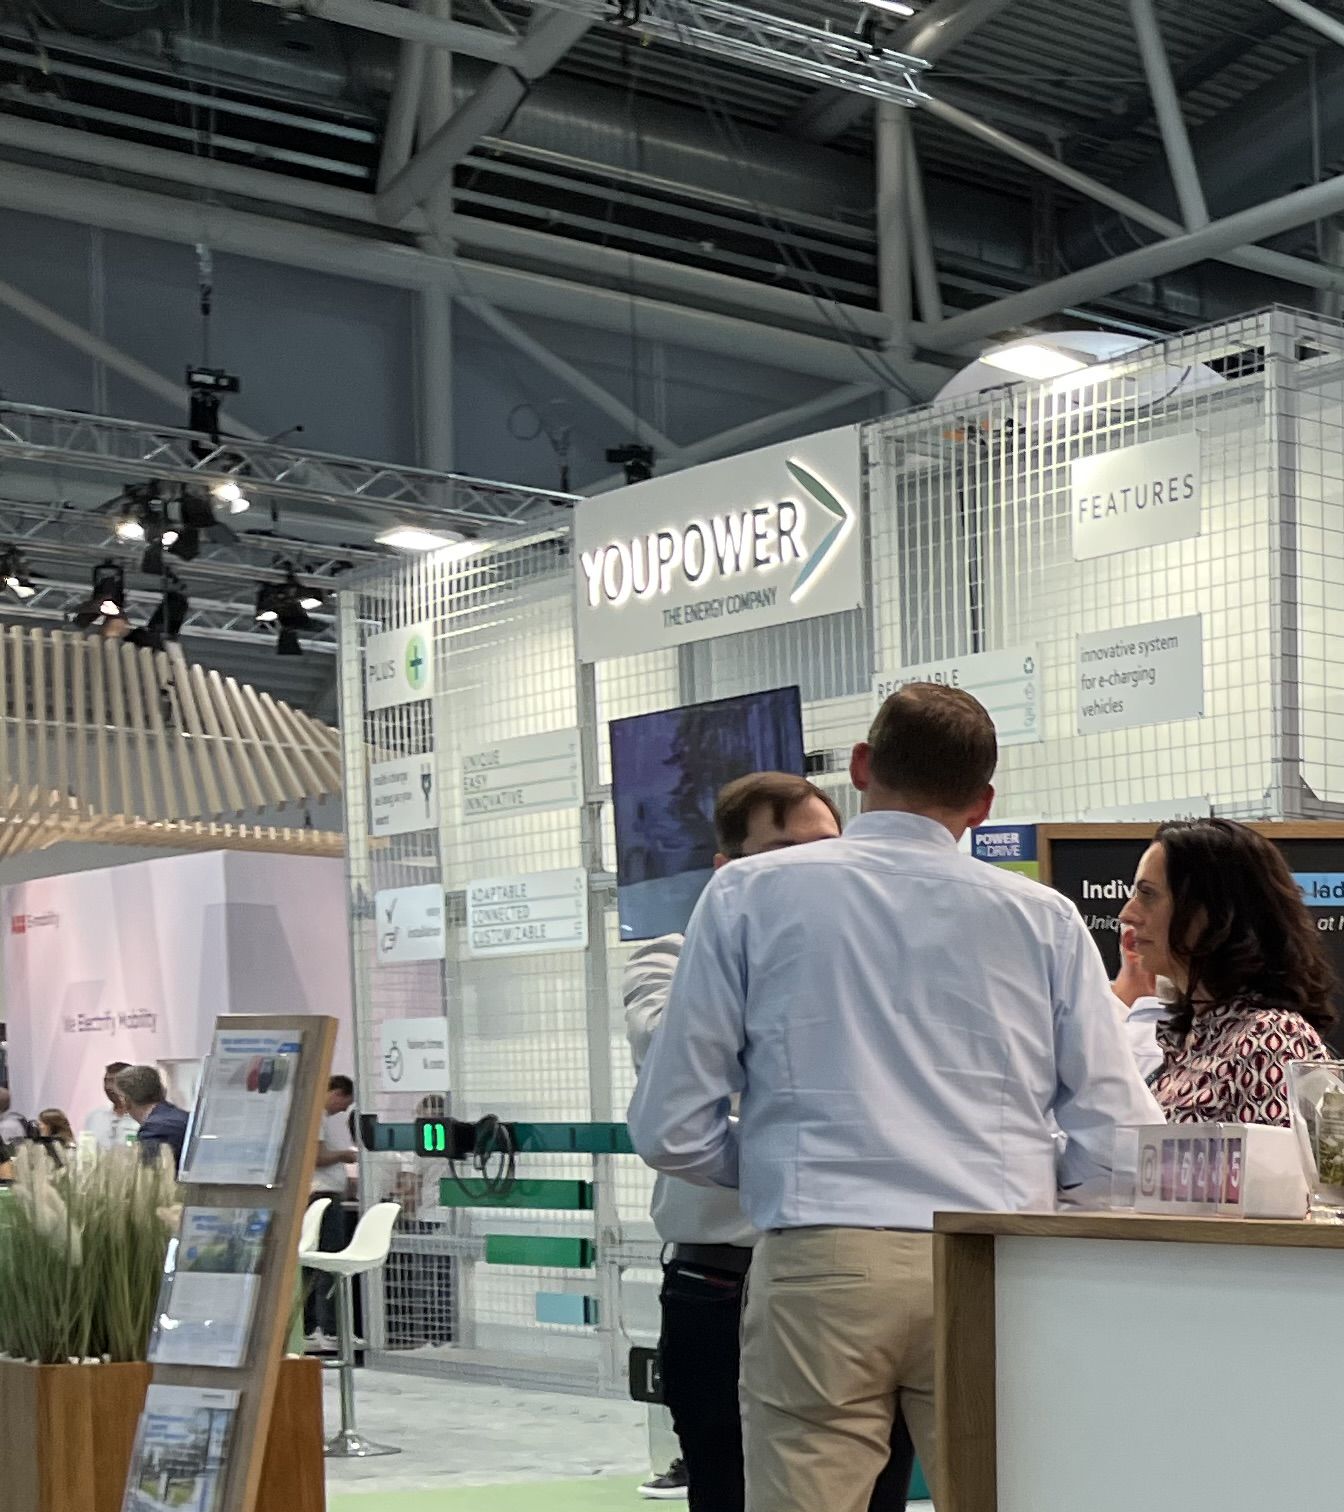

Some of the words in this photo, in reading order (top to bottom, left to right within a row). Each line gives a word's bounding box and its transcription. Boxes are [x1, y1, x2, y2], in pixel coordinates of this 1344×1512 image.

[1079, 474, 1193, 523] FEATURES
[579, 501, 802, 607] YOUPOWER
[662, 607, 683, 628] THE
[684, 597, 724, 623] ENERGY
[726, 586, 777, 614] COMPANY
[1080, 640, 1136, 663] innovative
[1138, 636, 1179, 658] system
[1081, 673, 1096, 690] for
[1098, 665, 1156, 688] e-charging
[1082, 697, 1124, 717] vehicles
[975, 832, 1020, 846] POWER
[1083, 880, 1136, 899] Indiv
[1083, 914, 1120, 933] Uniq
[1317, 917, 1335, 931] at
